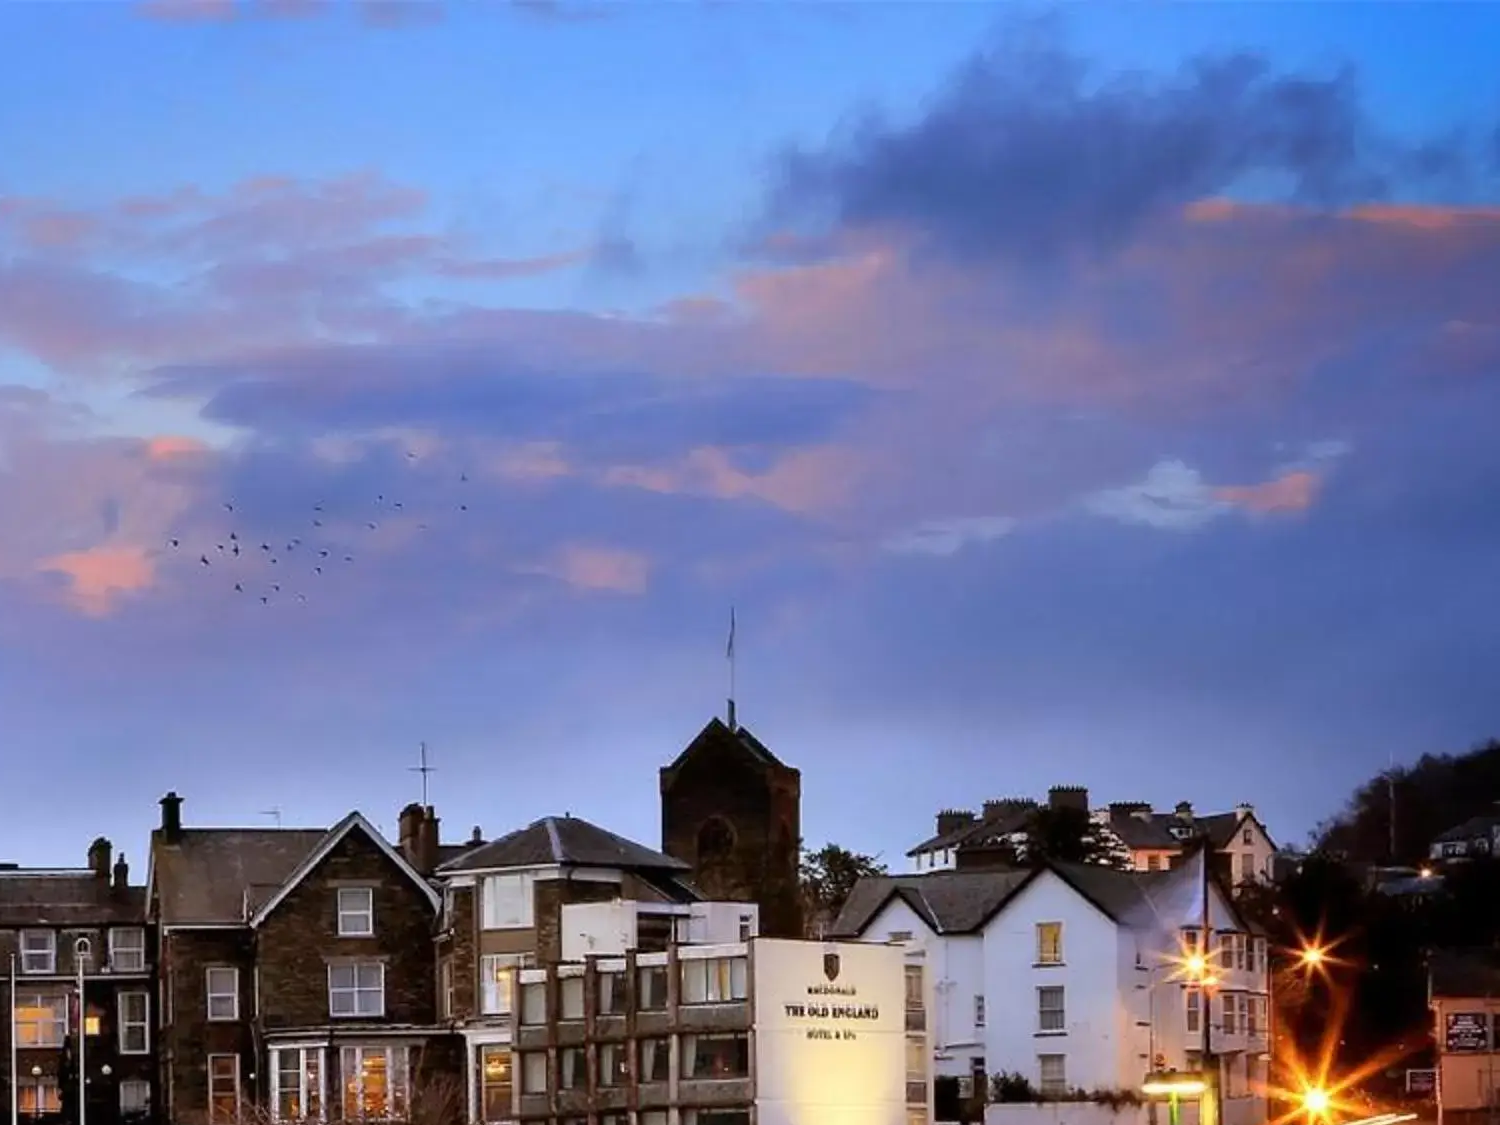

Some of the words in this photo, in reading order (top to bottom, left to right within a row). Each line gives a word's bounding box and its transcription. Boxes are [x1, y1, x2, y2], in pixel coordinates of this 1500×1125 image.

[785, 1005, 805, 1017] THE
[808, 1006, 829, 1018] OLD
[832, 1006, 879, 1020] ENGLAND
[806, 1029, 832, 1040] HOTEL
